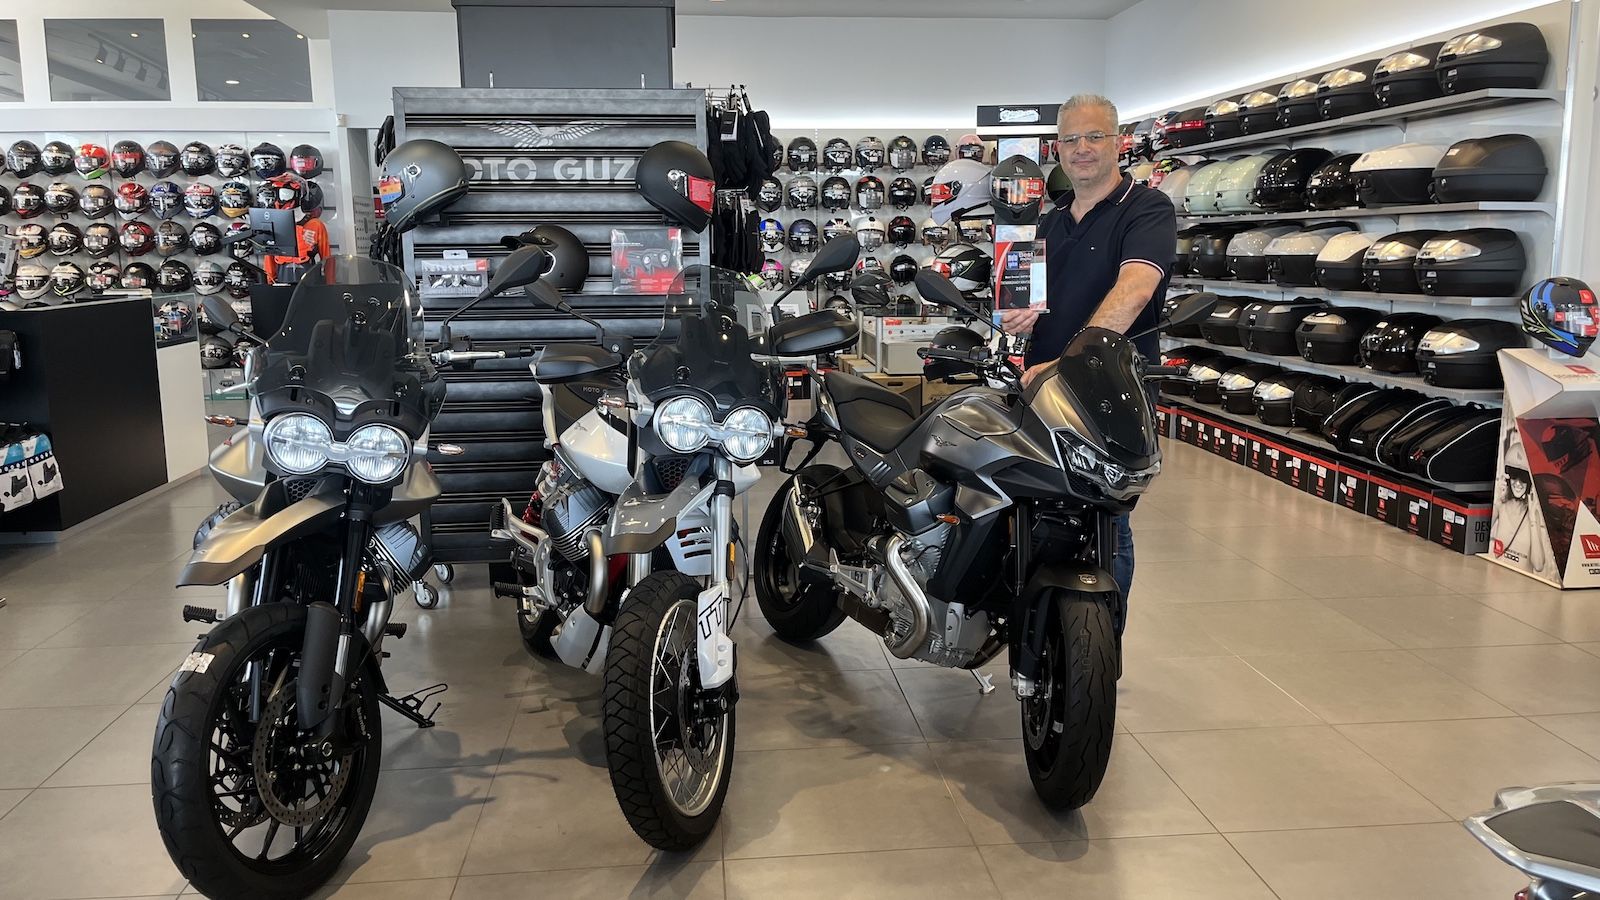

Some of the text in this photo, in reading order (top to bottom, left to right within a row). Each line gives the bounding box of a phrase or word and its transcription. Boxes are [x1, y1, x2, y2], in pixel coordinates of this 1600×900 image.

[463, 157, 636, 184] OTO GUZ
[698, 591, 722, 640] TT
